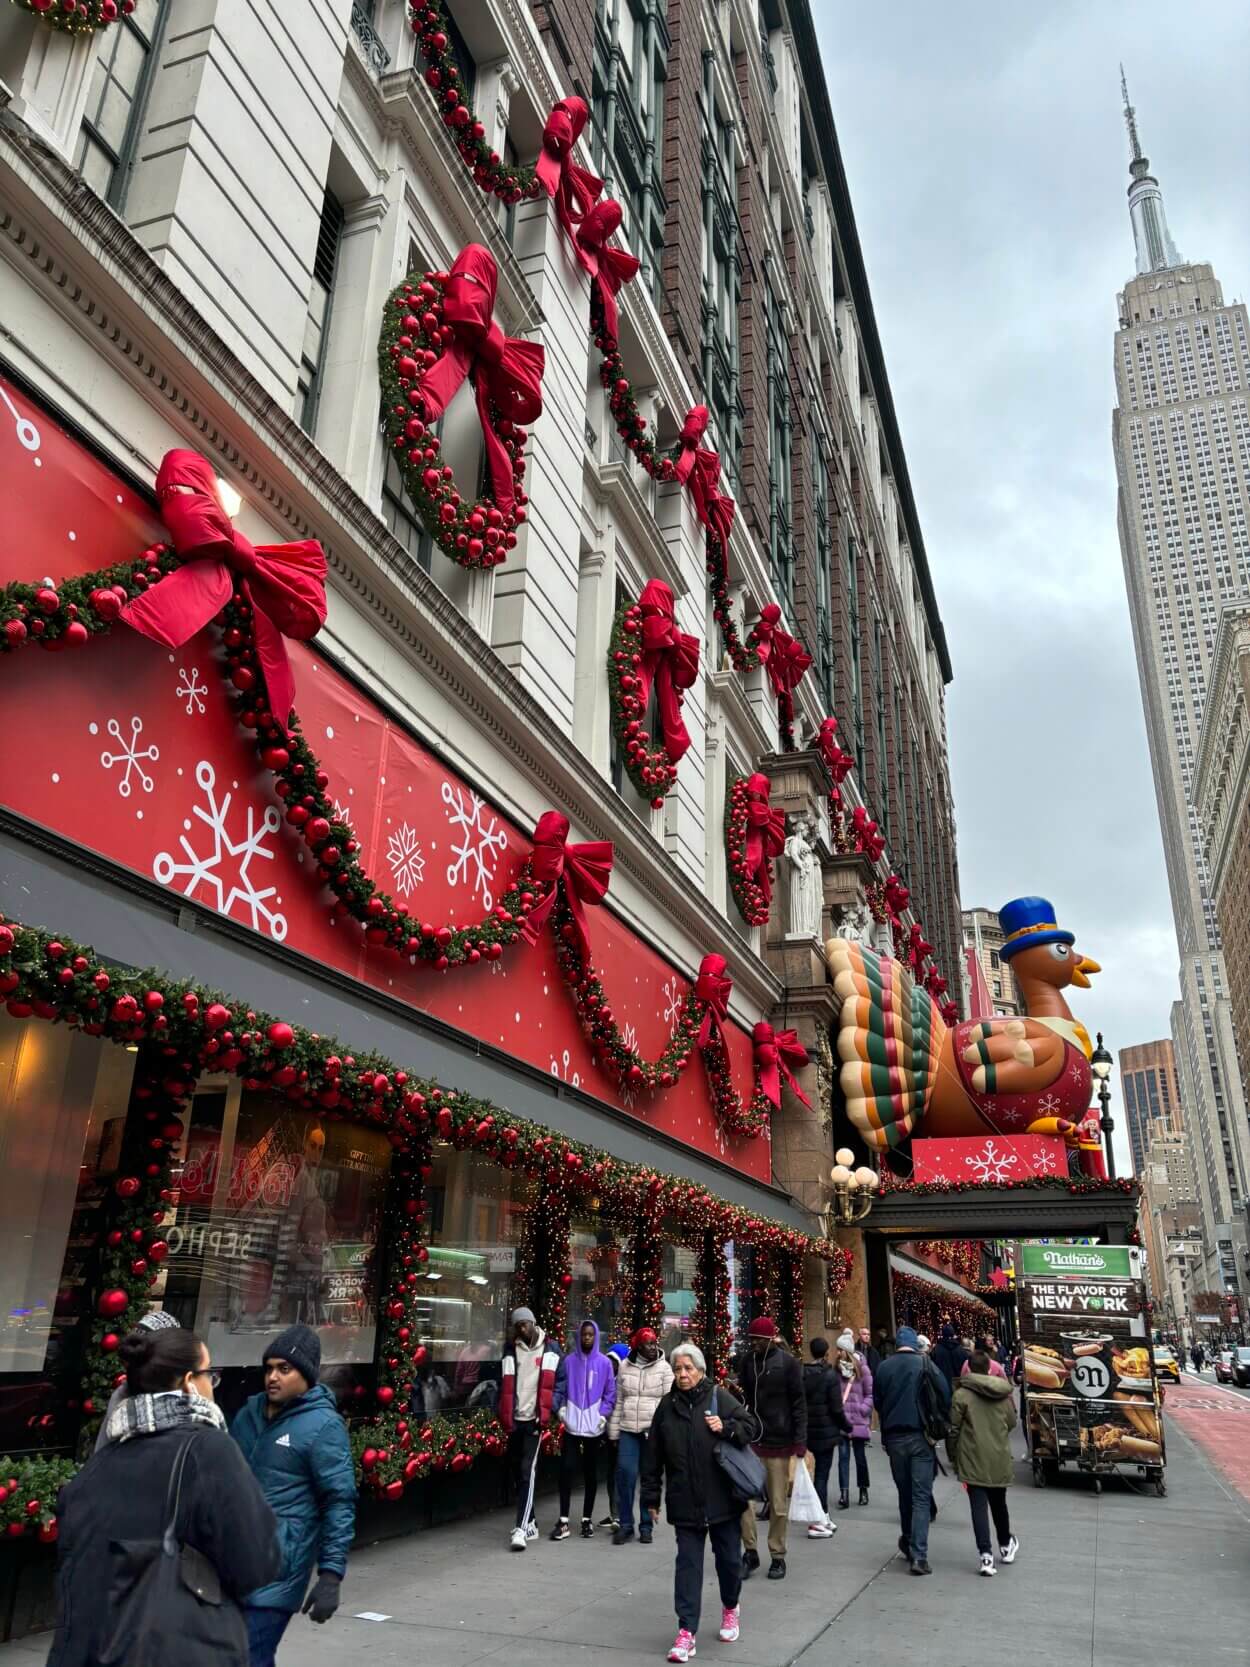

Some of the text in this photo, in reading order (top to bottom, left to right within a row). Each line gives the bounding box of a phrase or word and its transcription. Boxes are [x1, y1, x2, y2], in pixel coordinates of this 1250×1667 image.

[1043, 1251, 1106, 1267] Nathan's
[1031, 1284, 1127, 1297] THE FLAVOR OF
[1032, 1296, 1074, 1309] NEW
